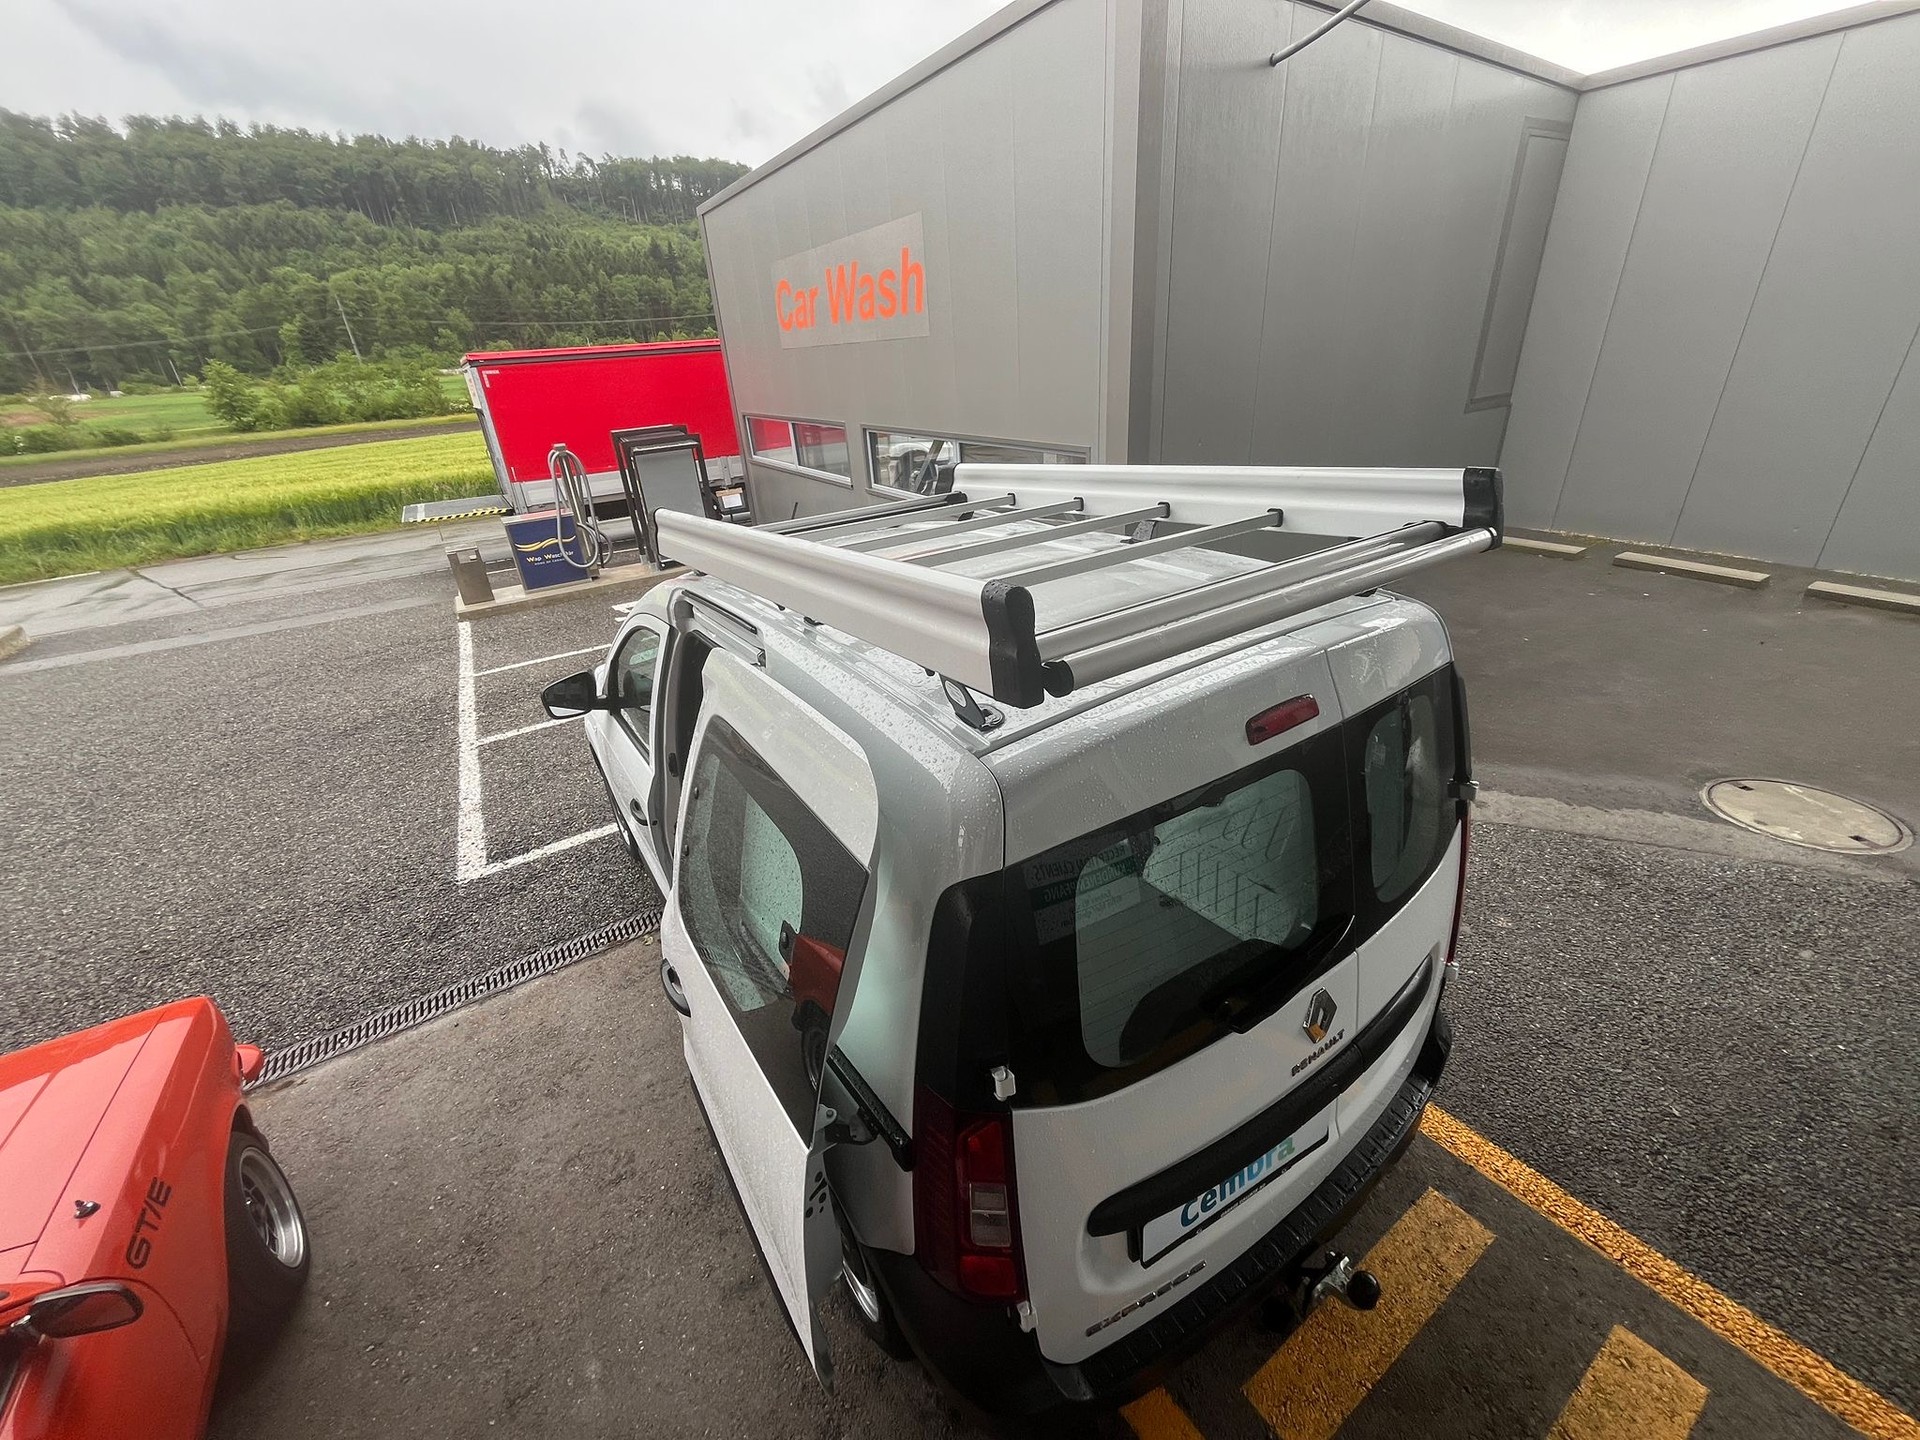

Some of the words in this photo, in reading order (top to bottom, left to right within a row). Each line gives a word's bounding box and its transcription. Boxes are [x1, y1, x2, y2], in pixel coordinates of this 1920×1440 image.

[775, 279, 820, 332] Car
[824, 245, 925, 325] Wash
[1291, 1028, 1345, 1077] RENAULT
[126, 1176, 172, 1270] GT/E
